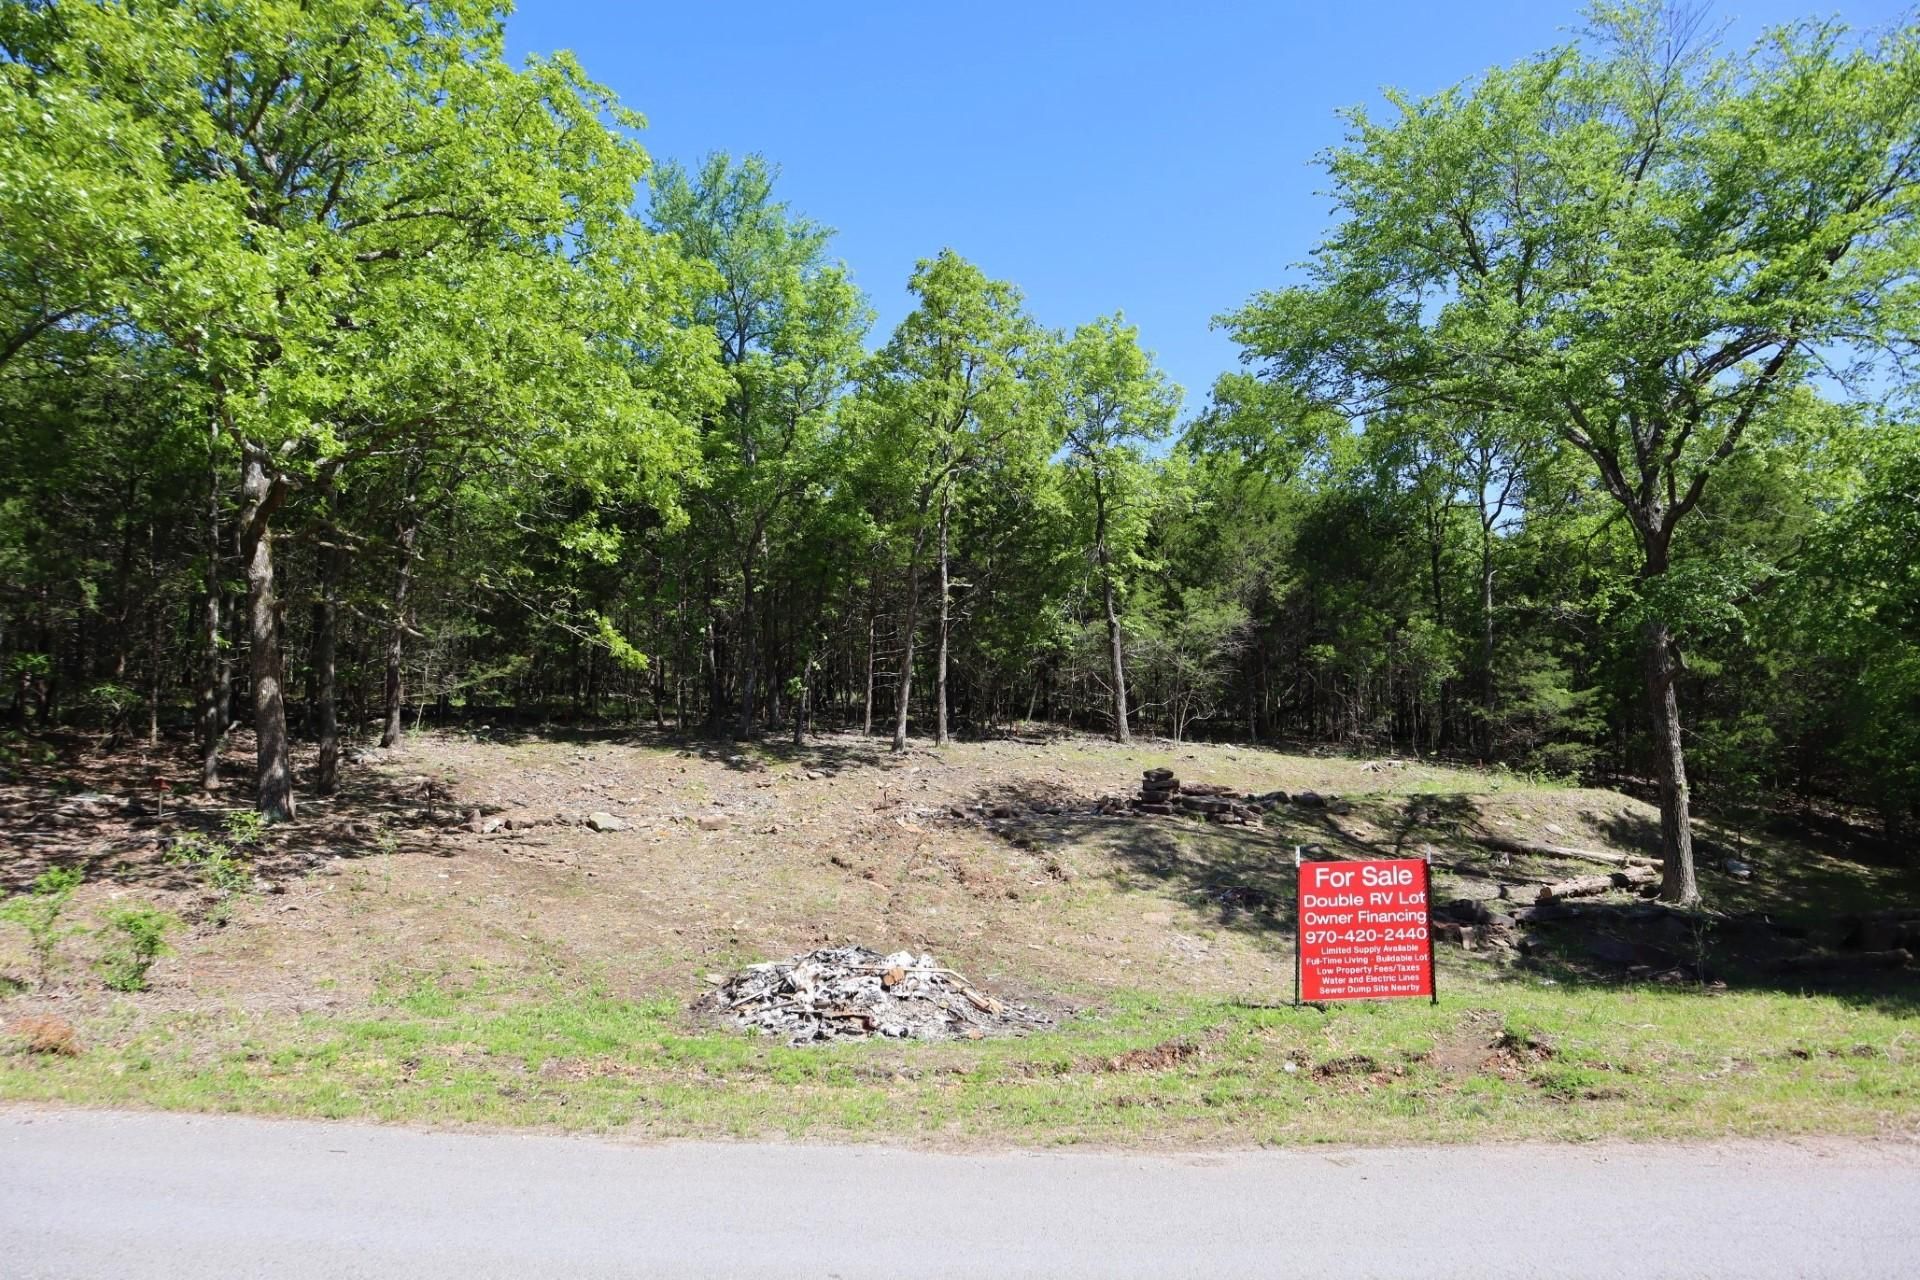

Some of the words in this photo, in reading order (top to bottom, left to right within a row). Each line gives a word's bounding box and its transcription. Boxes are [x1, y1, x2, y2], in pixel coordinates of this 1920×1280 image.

[1315, 868, 1355, 887] For
[1362, 866, 1412, 886] Sale
[1304, 894, 1363, 907] Double
[1370, 893, 1393, 905] RV
[1399, 891, 1425, 904] Lot
[1305, 913, 1353, 925] Owner
[1358, 910, 1426, 924] Financing
[1306, 928, 1427, 944] 970-420-2440
